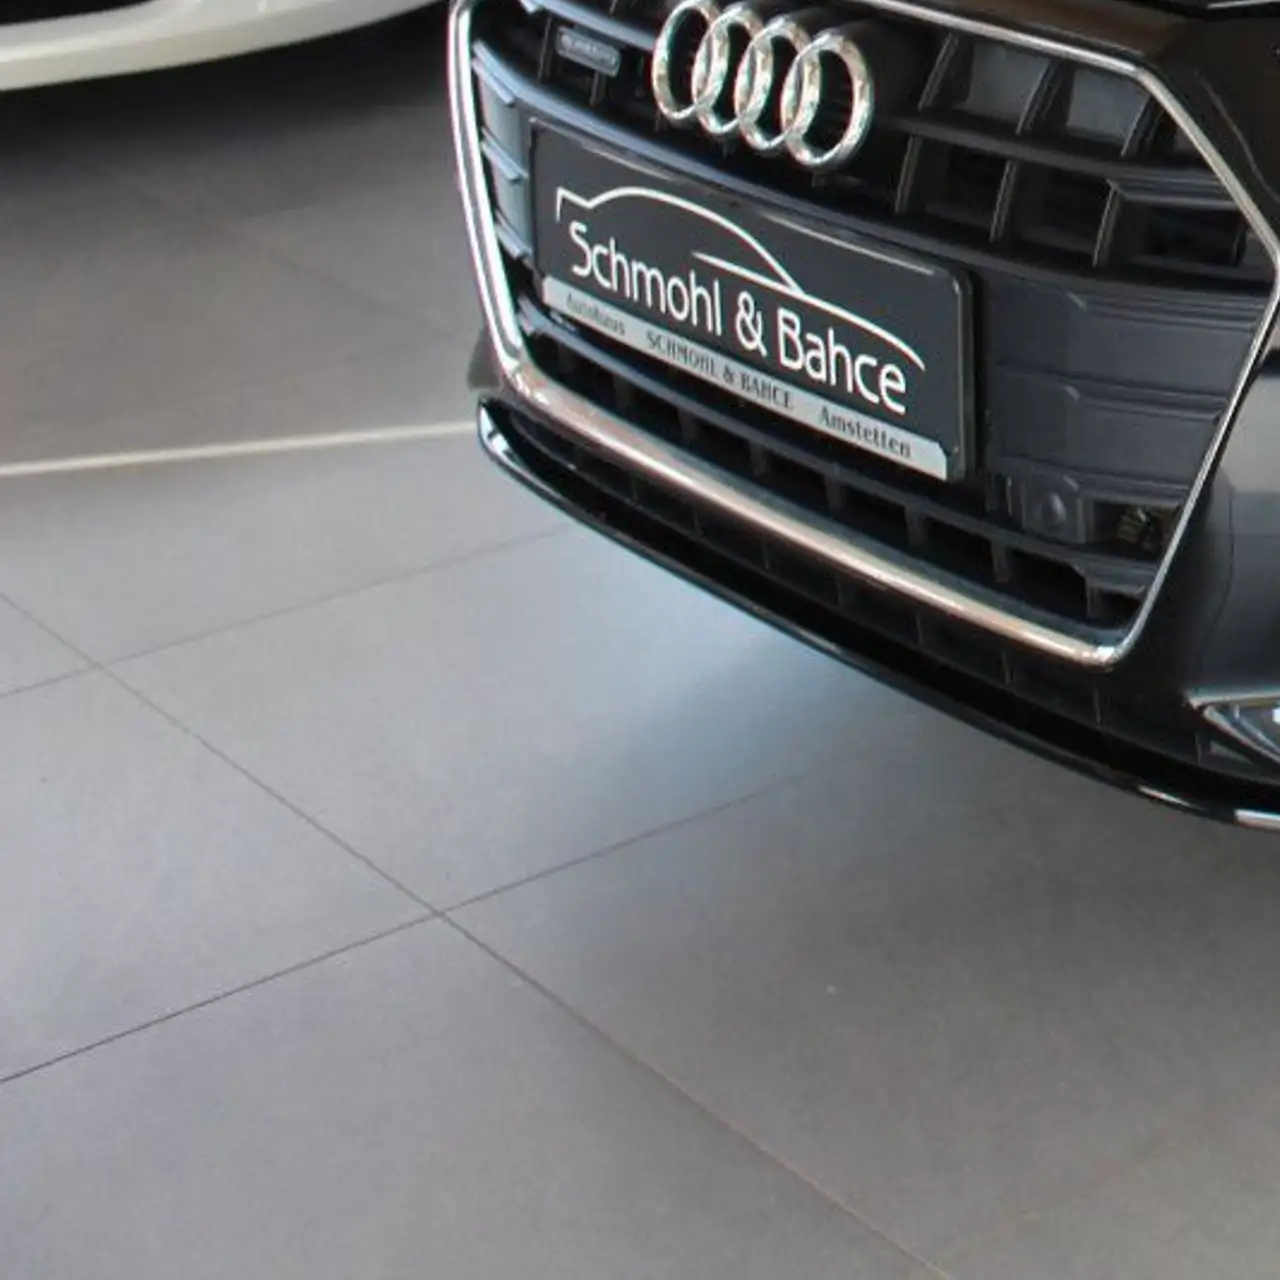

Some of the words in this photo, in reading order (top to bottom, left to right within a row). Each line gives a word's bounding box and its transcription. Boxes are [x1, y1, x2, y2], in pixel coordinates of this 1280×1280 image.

[570, 221, 722, 336] Schmohl
[736, 290, 768, 357] &
[777, 306, 906, 415] Bahce
[645, 329, 719, 380] SCHMOHL
[723, 364, 736, 386] &
[739, 371, 795, 410] BAHCE
[816, 406, 911, 459] Amstetten
